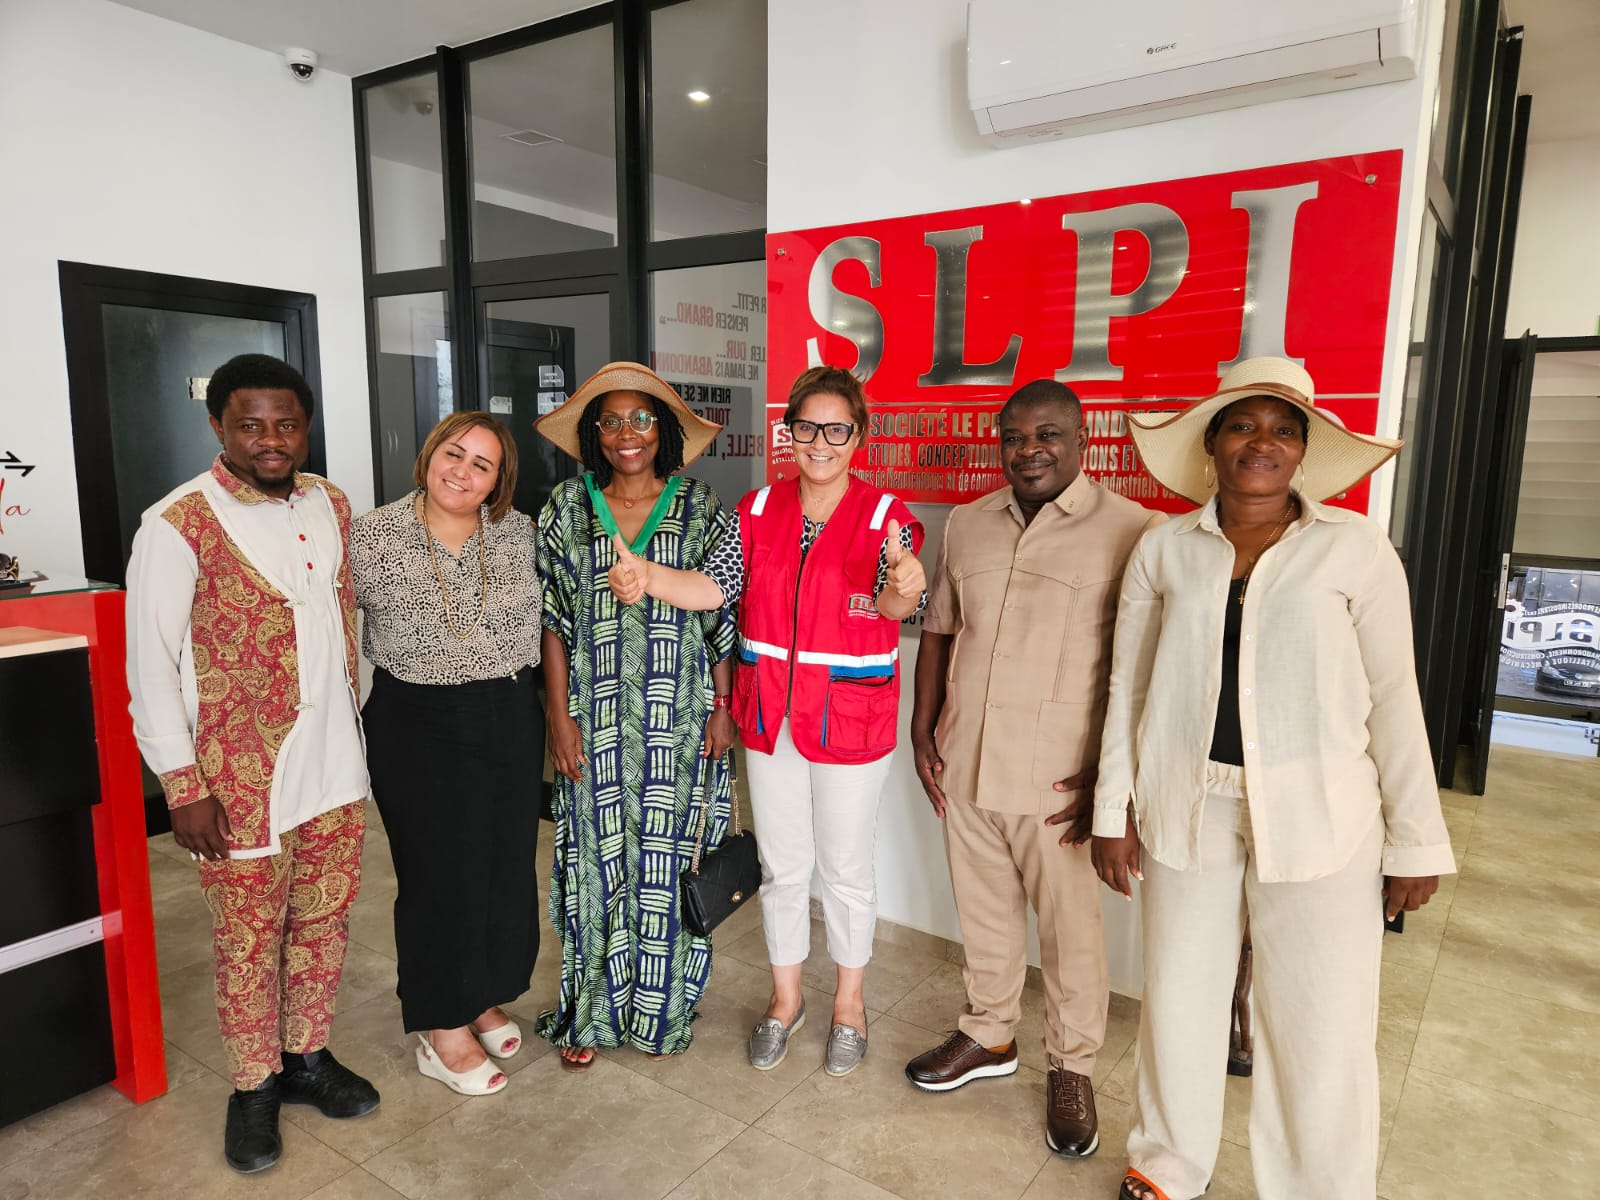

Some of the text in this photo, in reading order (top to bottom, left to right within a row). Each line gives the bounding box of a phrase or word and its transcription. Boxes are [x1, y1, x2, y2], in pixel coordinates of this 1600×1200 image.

[807, 181, 1319, 387] SLPI
[869, 408, 947, 437] SOCIÉTÉ
[952, 411, 973, 438] LE
[918, 443, 1003, 469] CONCEPTION
[958, 469, 969, 492] de
